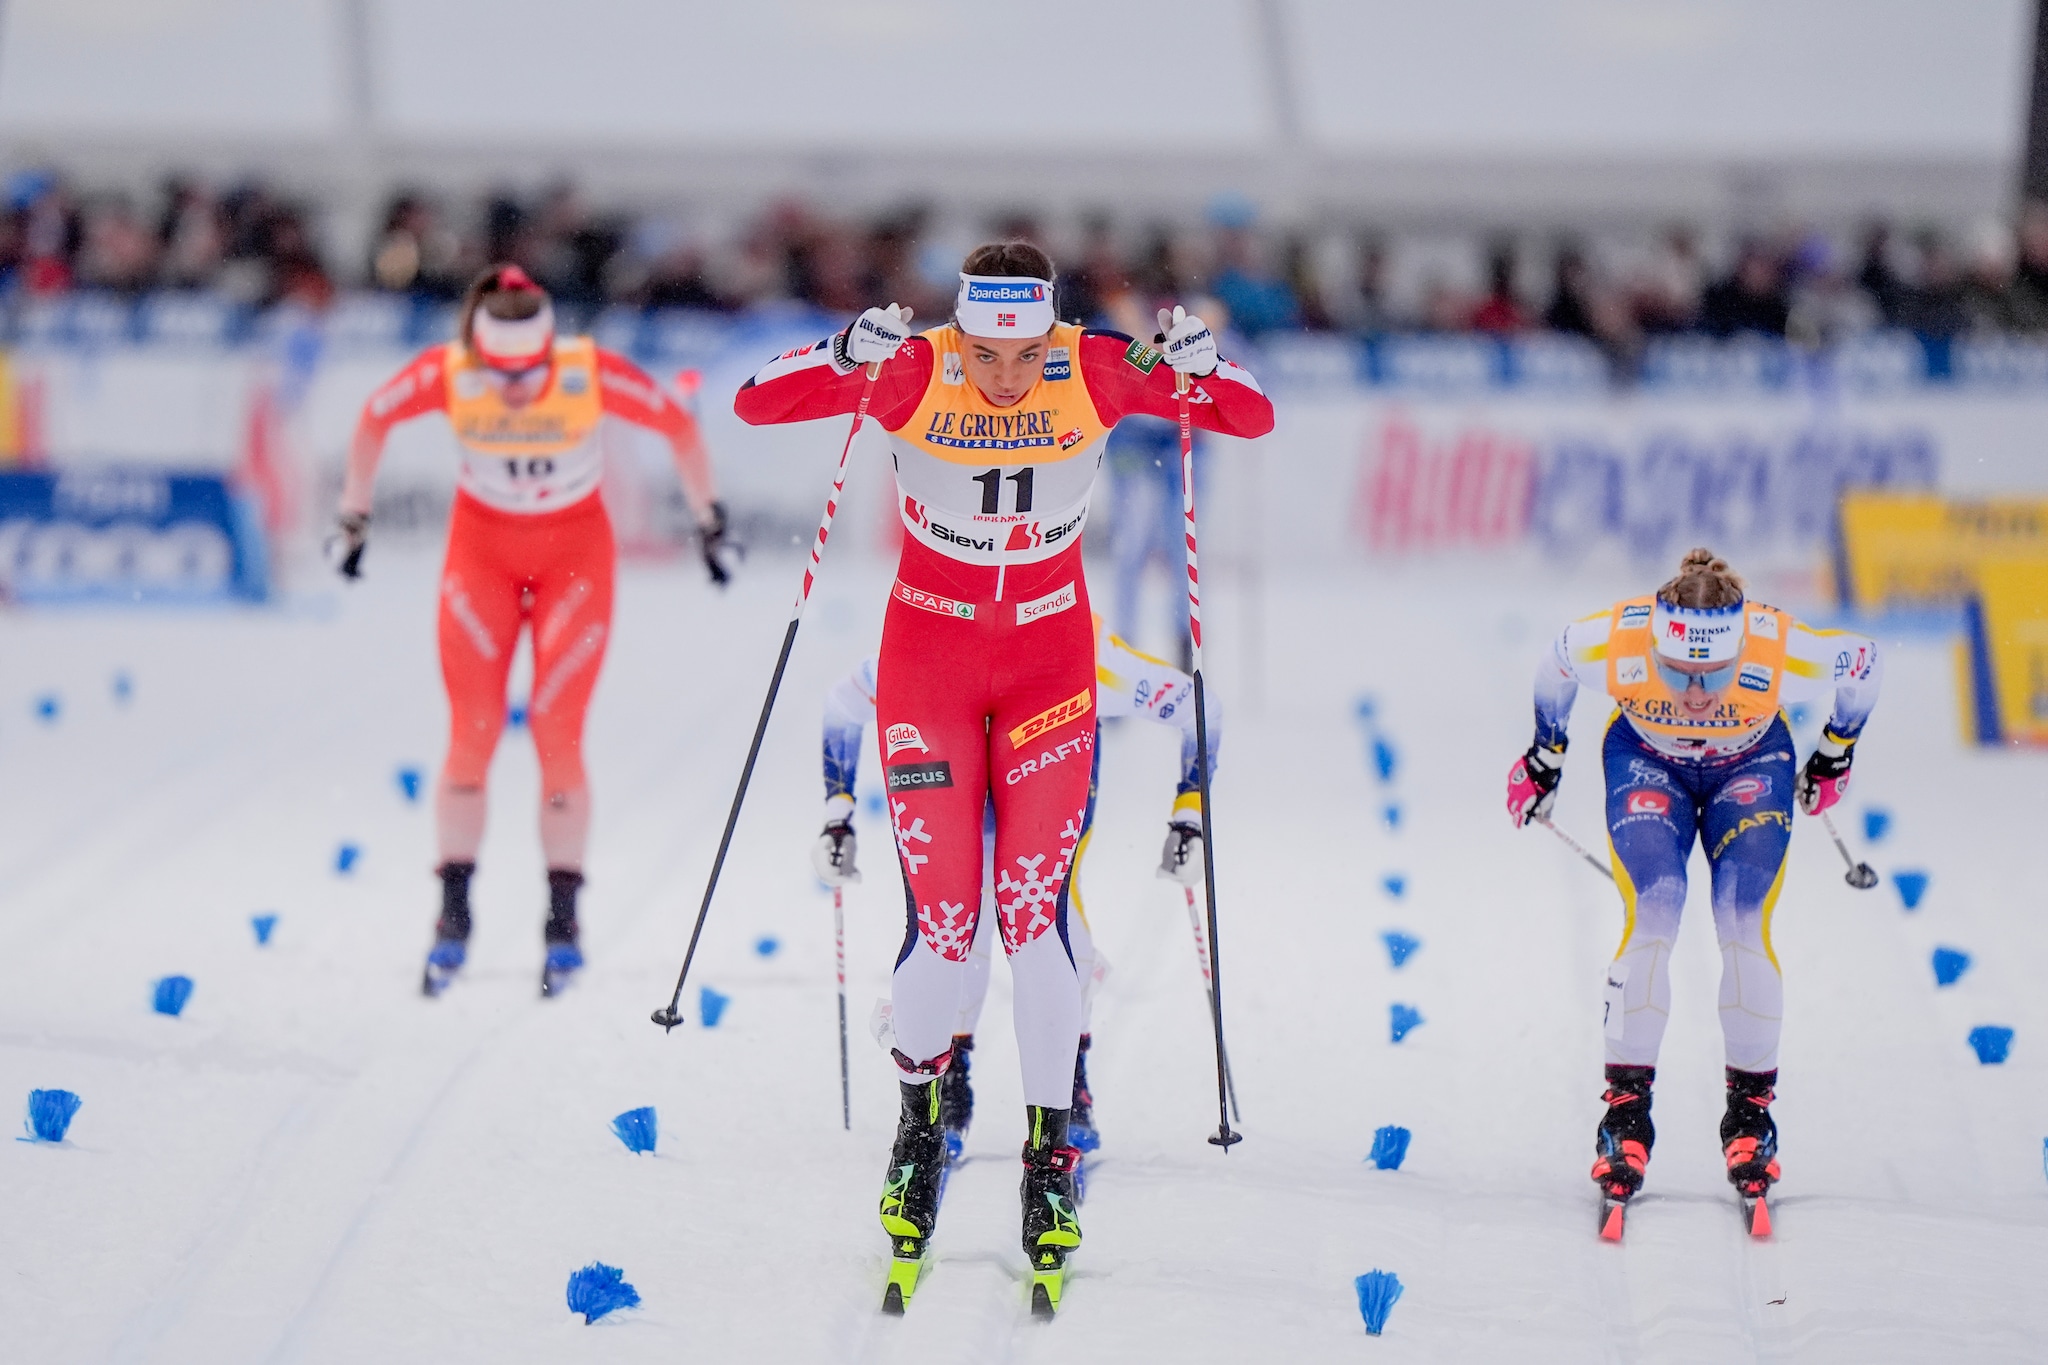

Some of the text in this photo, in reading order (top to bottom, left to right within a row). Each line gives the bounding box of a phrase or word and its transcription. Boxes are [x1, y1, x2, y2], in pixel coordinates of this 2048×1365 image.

[969, 285, 1032, 301] SpareBank
[1043, 365, 1070, 376] coop
[928, 411, 956, 435] LE
[931, 434, 1049, 449] SWITZERLAND
[972, 467, 1034, 514] 11
[930, 521, 994, 552] Sievi
[901, 587, 953, 613] SPAR
[1023, 591, 1072, 619] Scandic
[1688, 635, 1714, 644] SPEL
[1689, 625, 1731, 636] SVENSKA
[1021, 698, 1085, 740] DHL
[888, 726, 918, 744] Gilde
[1005, 737, 1083, 786] CRAFT
[889, 769, 947, 788] abacus
[1712, 810, 1785, 860] CRAFT
